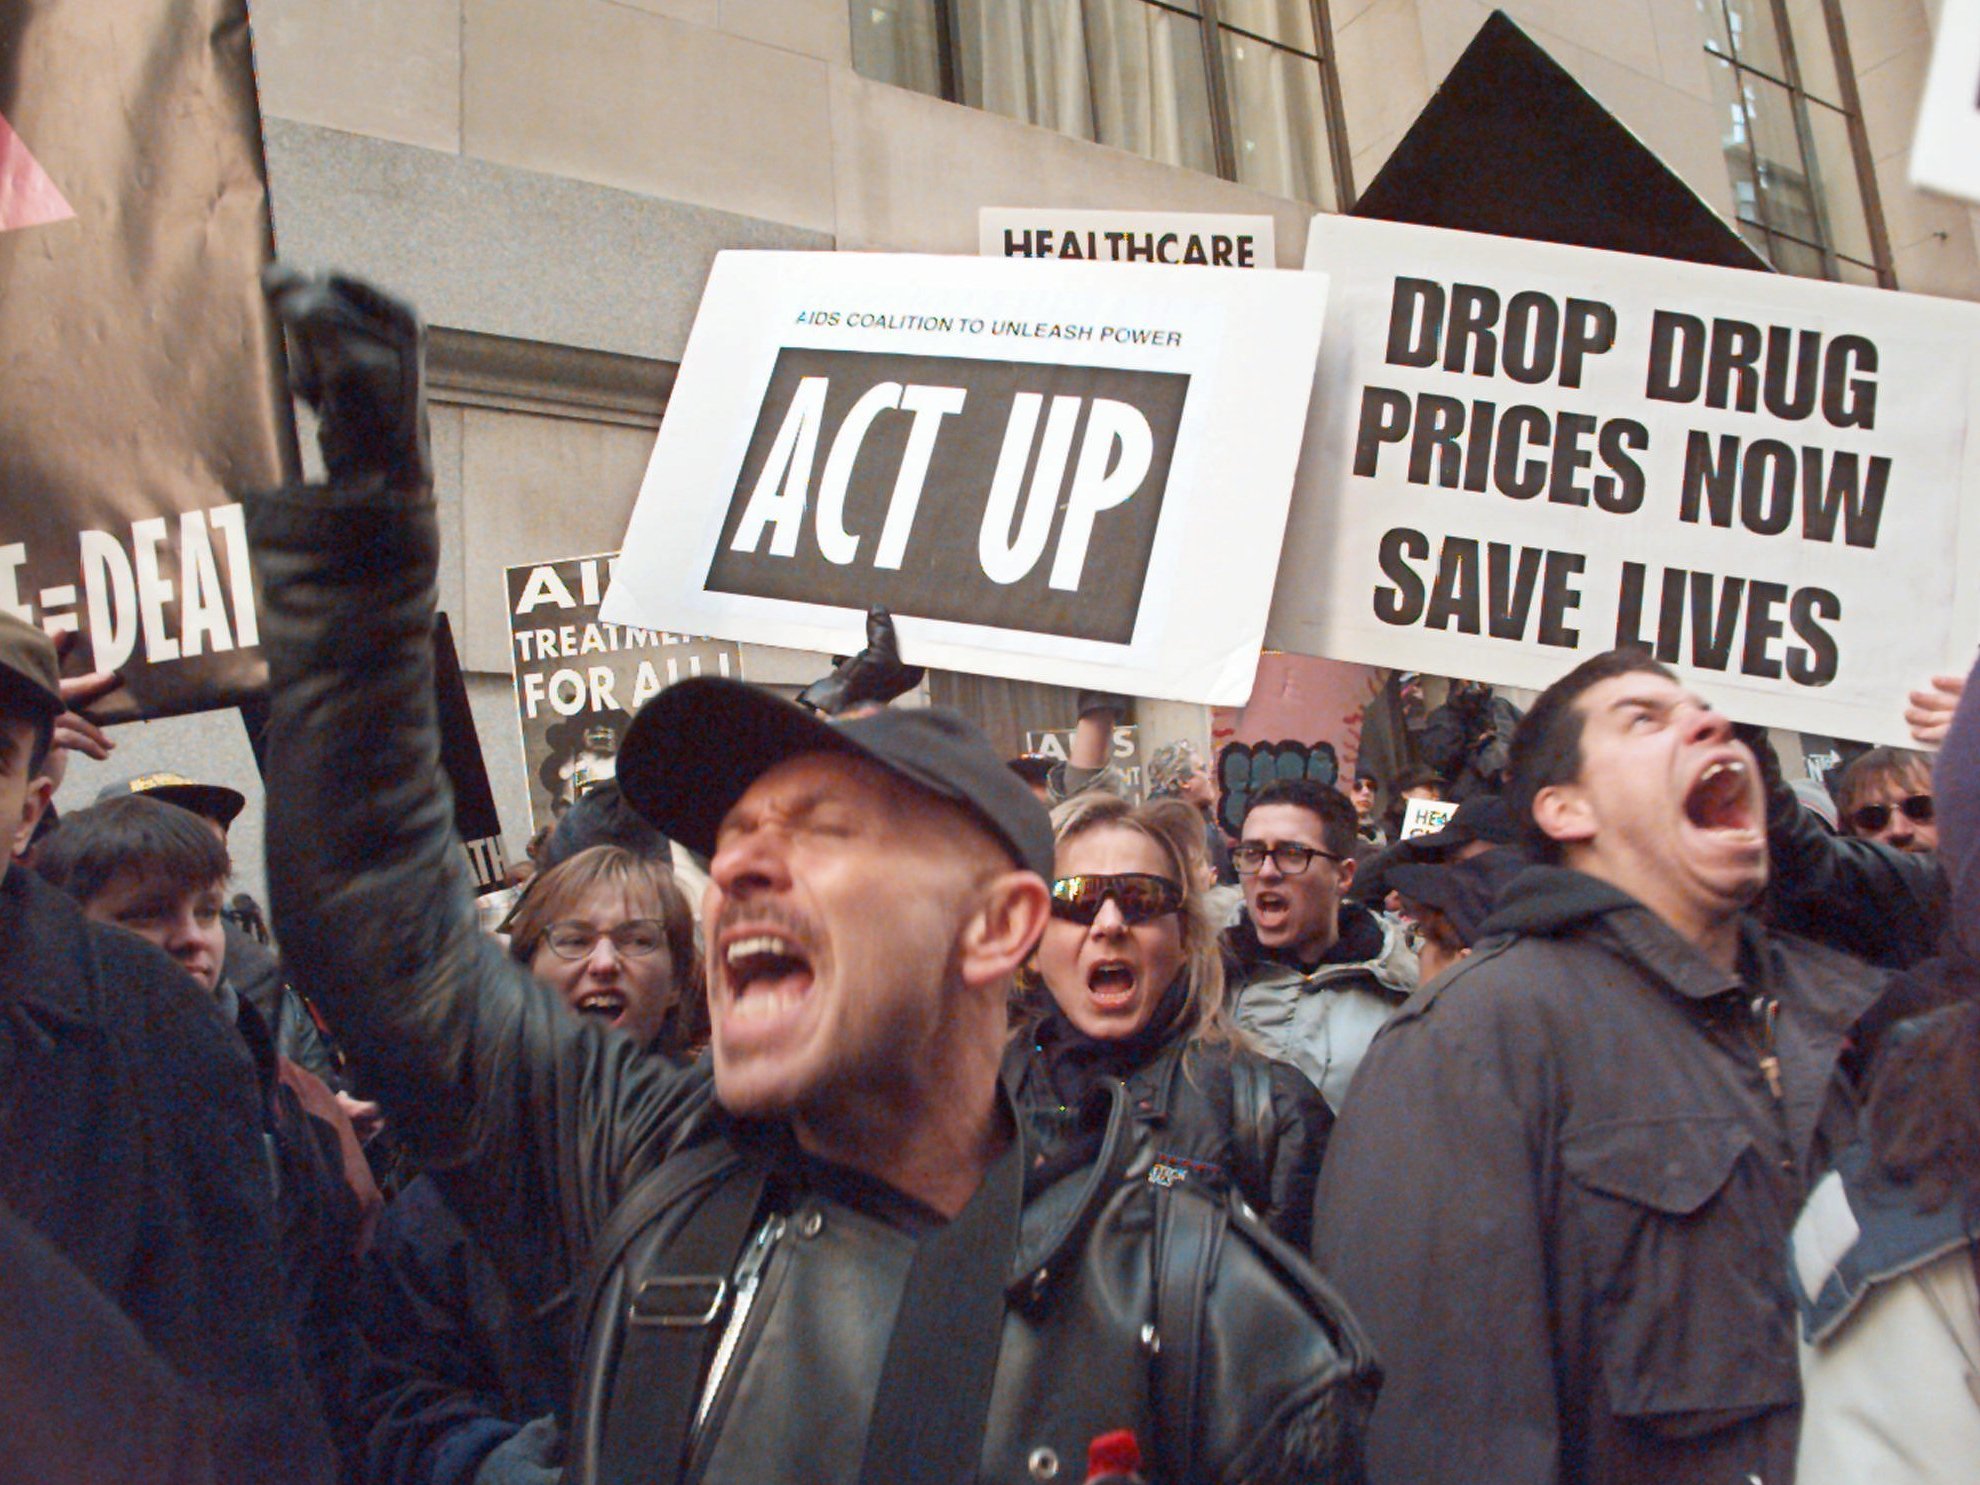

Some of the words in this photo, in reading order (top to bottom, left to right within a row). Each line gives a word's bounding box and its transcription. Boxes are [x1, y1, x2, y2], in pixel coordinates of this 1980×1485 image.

[796, 311, 841, 326] AIDS
[846, 312, 954, 331] COALITION
[958, 318, 985, 334] TO
[991, 319, 1093, 341] UNLEASH
[1100, 326, 1182, 346] POWER
[1385, 276, 1618, 389] DROP
[1645, 309, 1879, 430] DRUG
[730, 377, 967, 570] ACT
[978, 392, 1154, 592] UP
[1353, 385, 1650, 515] PRICES
[1679, 429, 1893, 549] NOW
[516, 558, 620, 614] AI
[1373, 527, 1587, 650] SAVE
[1615, 561, 1842, 687] LIVES
[524, 666, 621, 719] FOR
[1415, 809, 1448, 827] HEA
